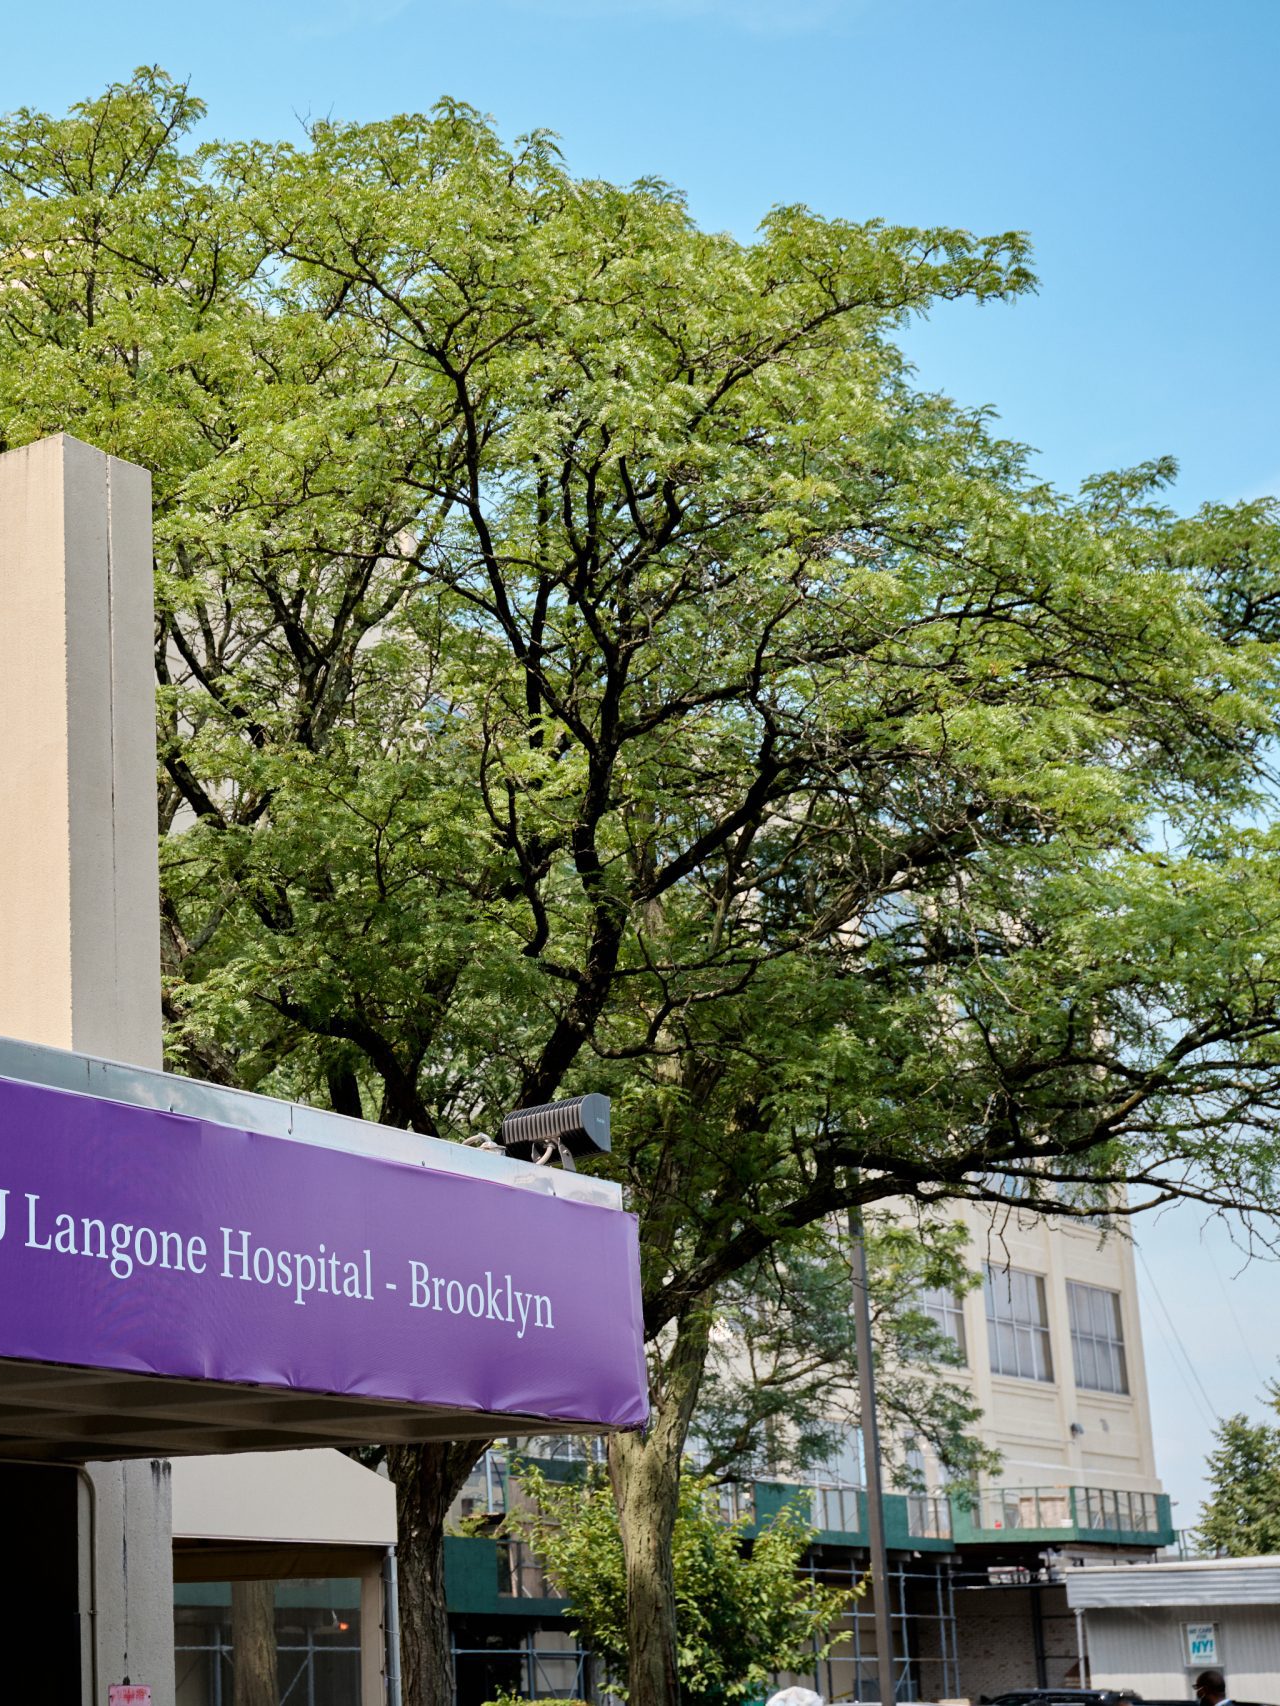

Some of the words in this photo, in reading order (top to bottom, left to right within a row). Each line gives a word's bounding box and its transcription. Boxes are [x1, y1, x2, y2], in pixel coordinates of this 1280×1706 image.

[24, 1193, 207, 1279] Langone
[219, 1227, 375, 1305] Hospital
[408, 1260, 555, 1339] Brooklyn
[1191, 1640, 1214, 1654] NY!
